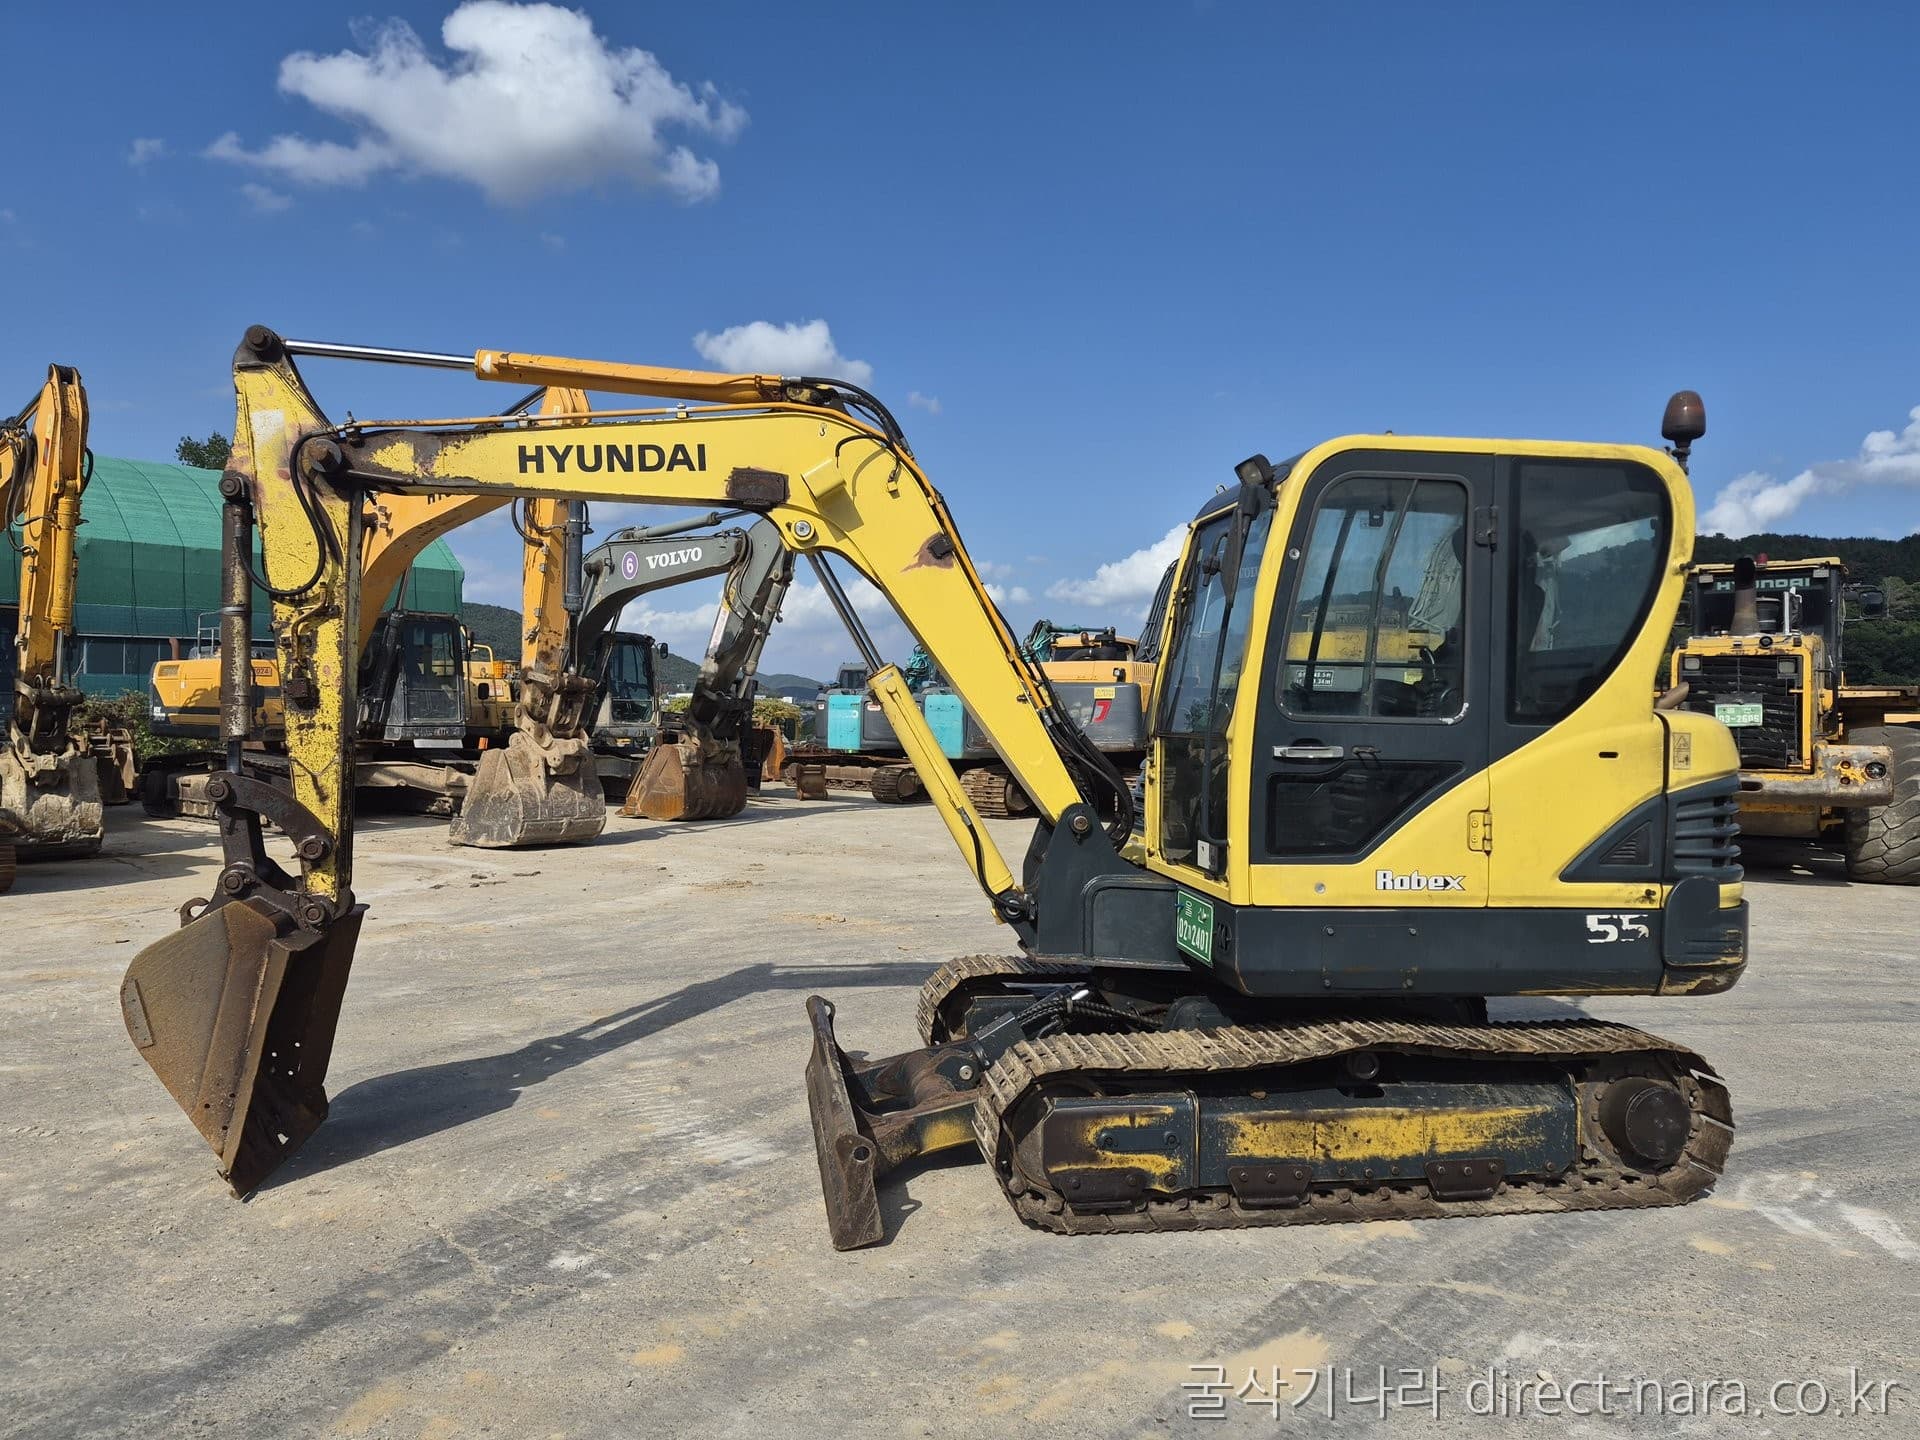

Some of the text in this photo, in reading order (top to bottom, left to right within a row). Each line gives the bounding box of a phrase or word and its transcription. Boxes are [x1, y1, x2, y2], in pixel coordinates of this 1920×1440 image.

[518, 443, 707, 474] HYUNDAI
[626, 557, 634, 573] 6
[646, 547, 703, 569] VOLVO
[1716, 577, 1810, 591] HNDAI
[1376, 869, 1466, 891] Robex
[1586, 914, 1650, 944] 55
